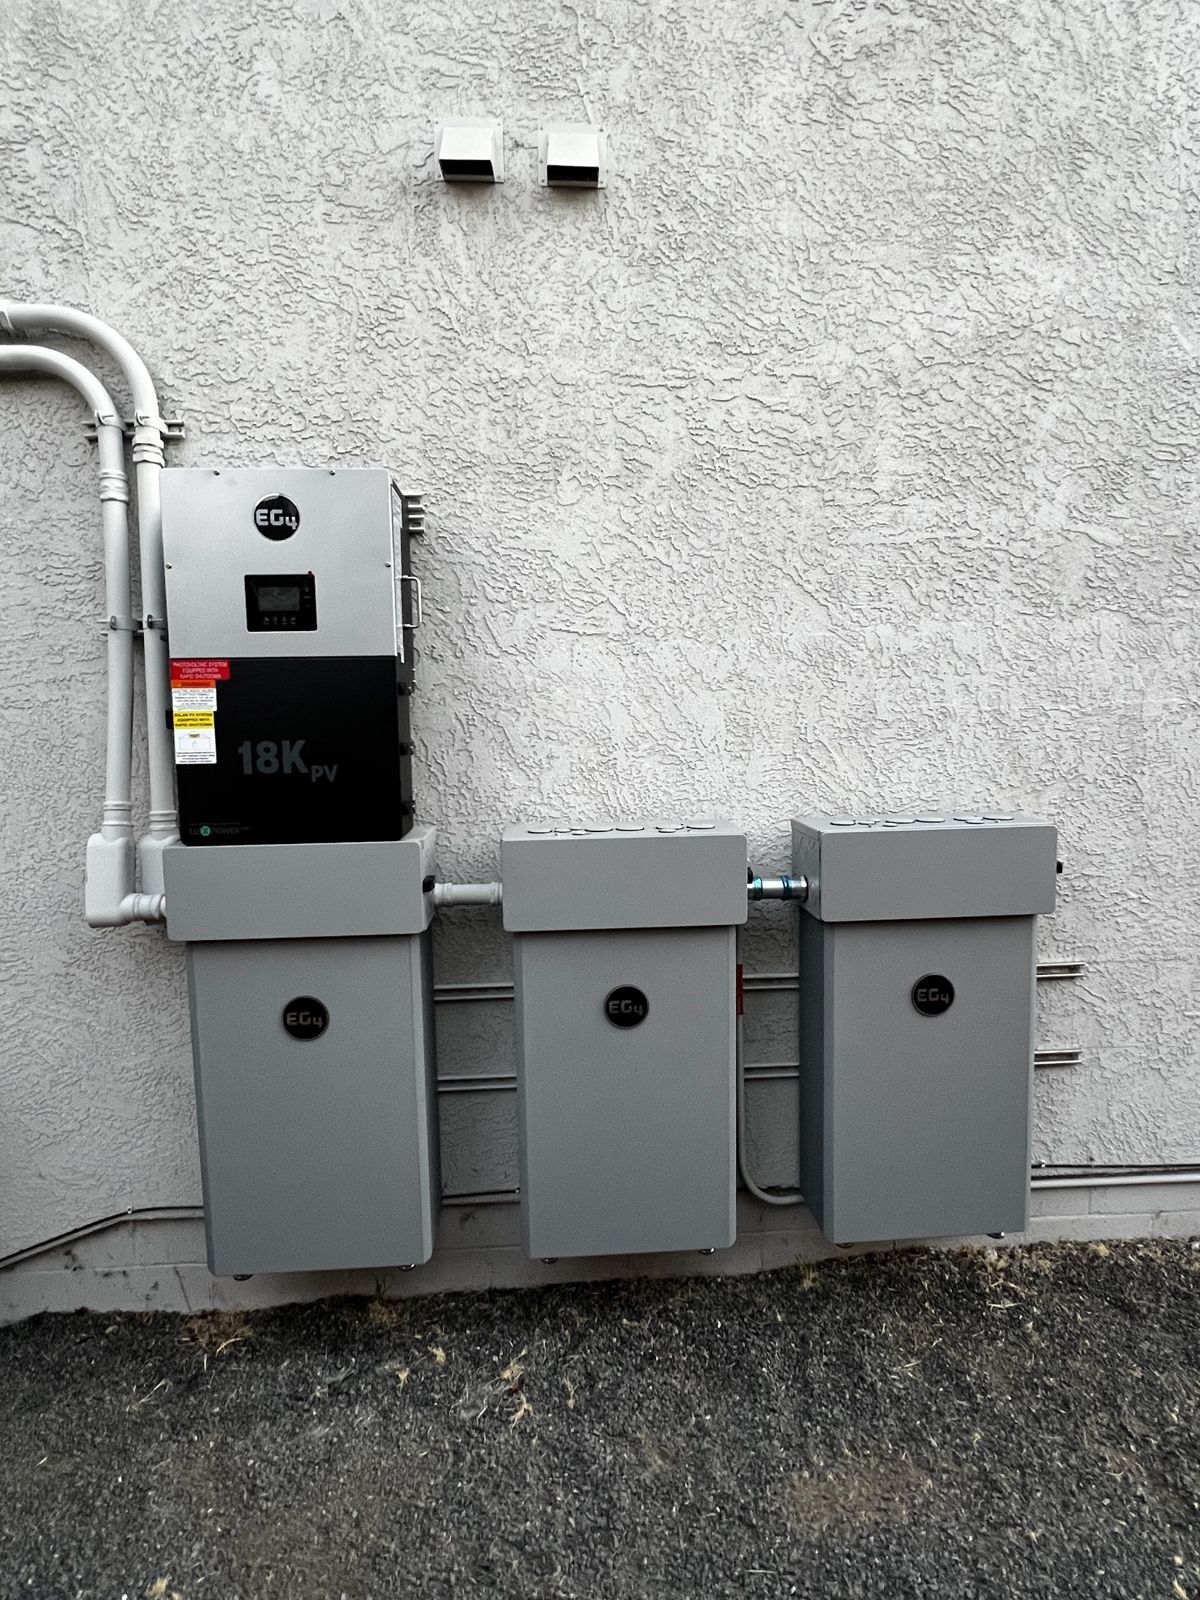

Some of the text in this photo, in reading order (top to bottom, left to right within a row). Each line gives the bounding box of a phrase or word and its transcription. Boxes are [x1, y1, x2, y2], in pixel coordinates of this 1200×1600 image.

[255, 508, 298, 530] EG4
[237, 739, 338, 783] 18K PV
[916, 988, 950, 1004] EG4
[608, 999, 644, 1016] EG4
[286, 1011, 324, 1028] EG4
